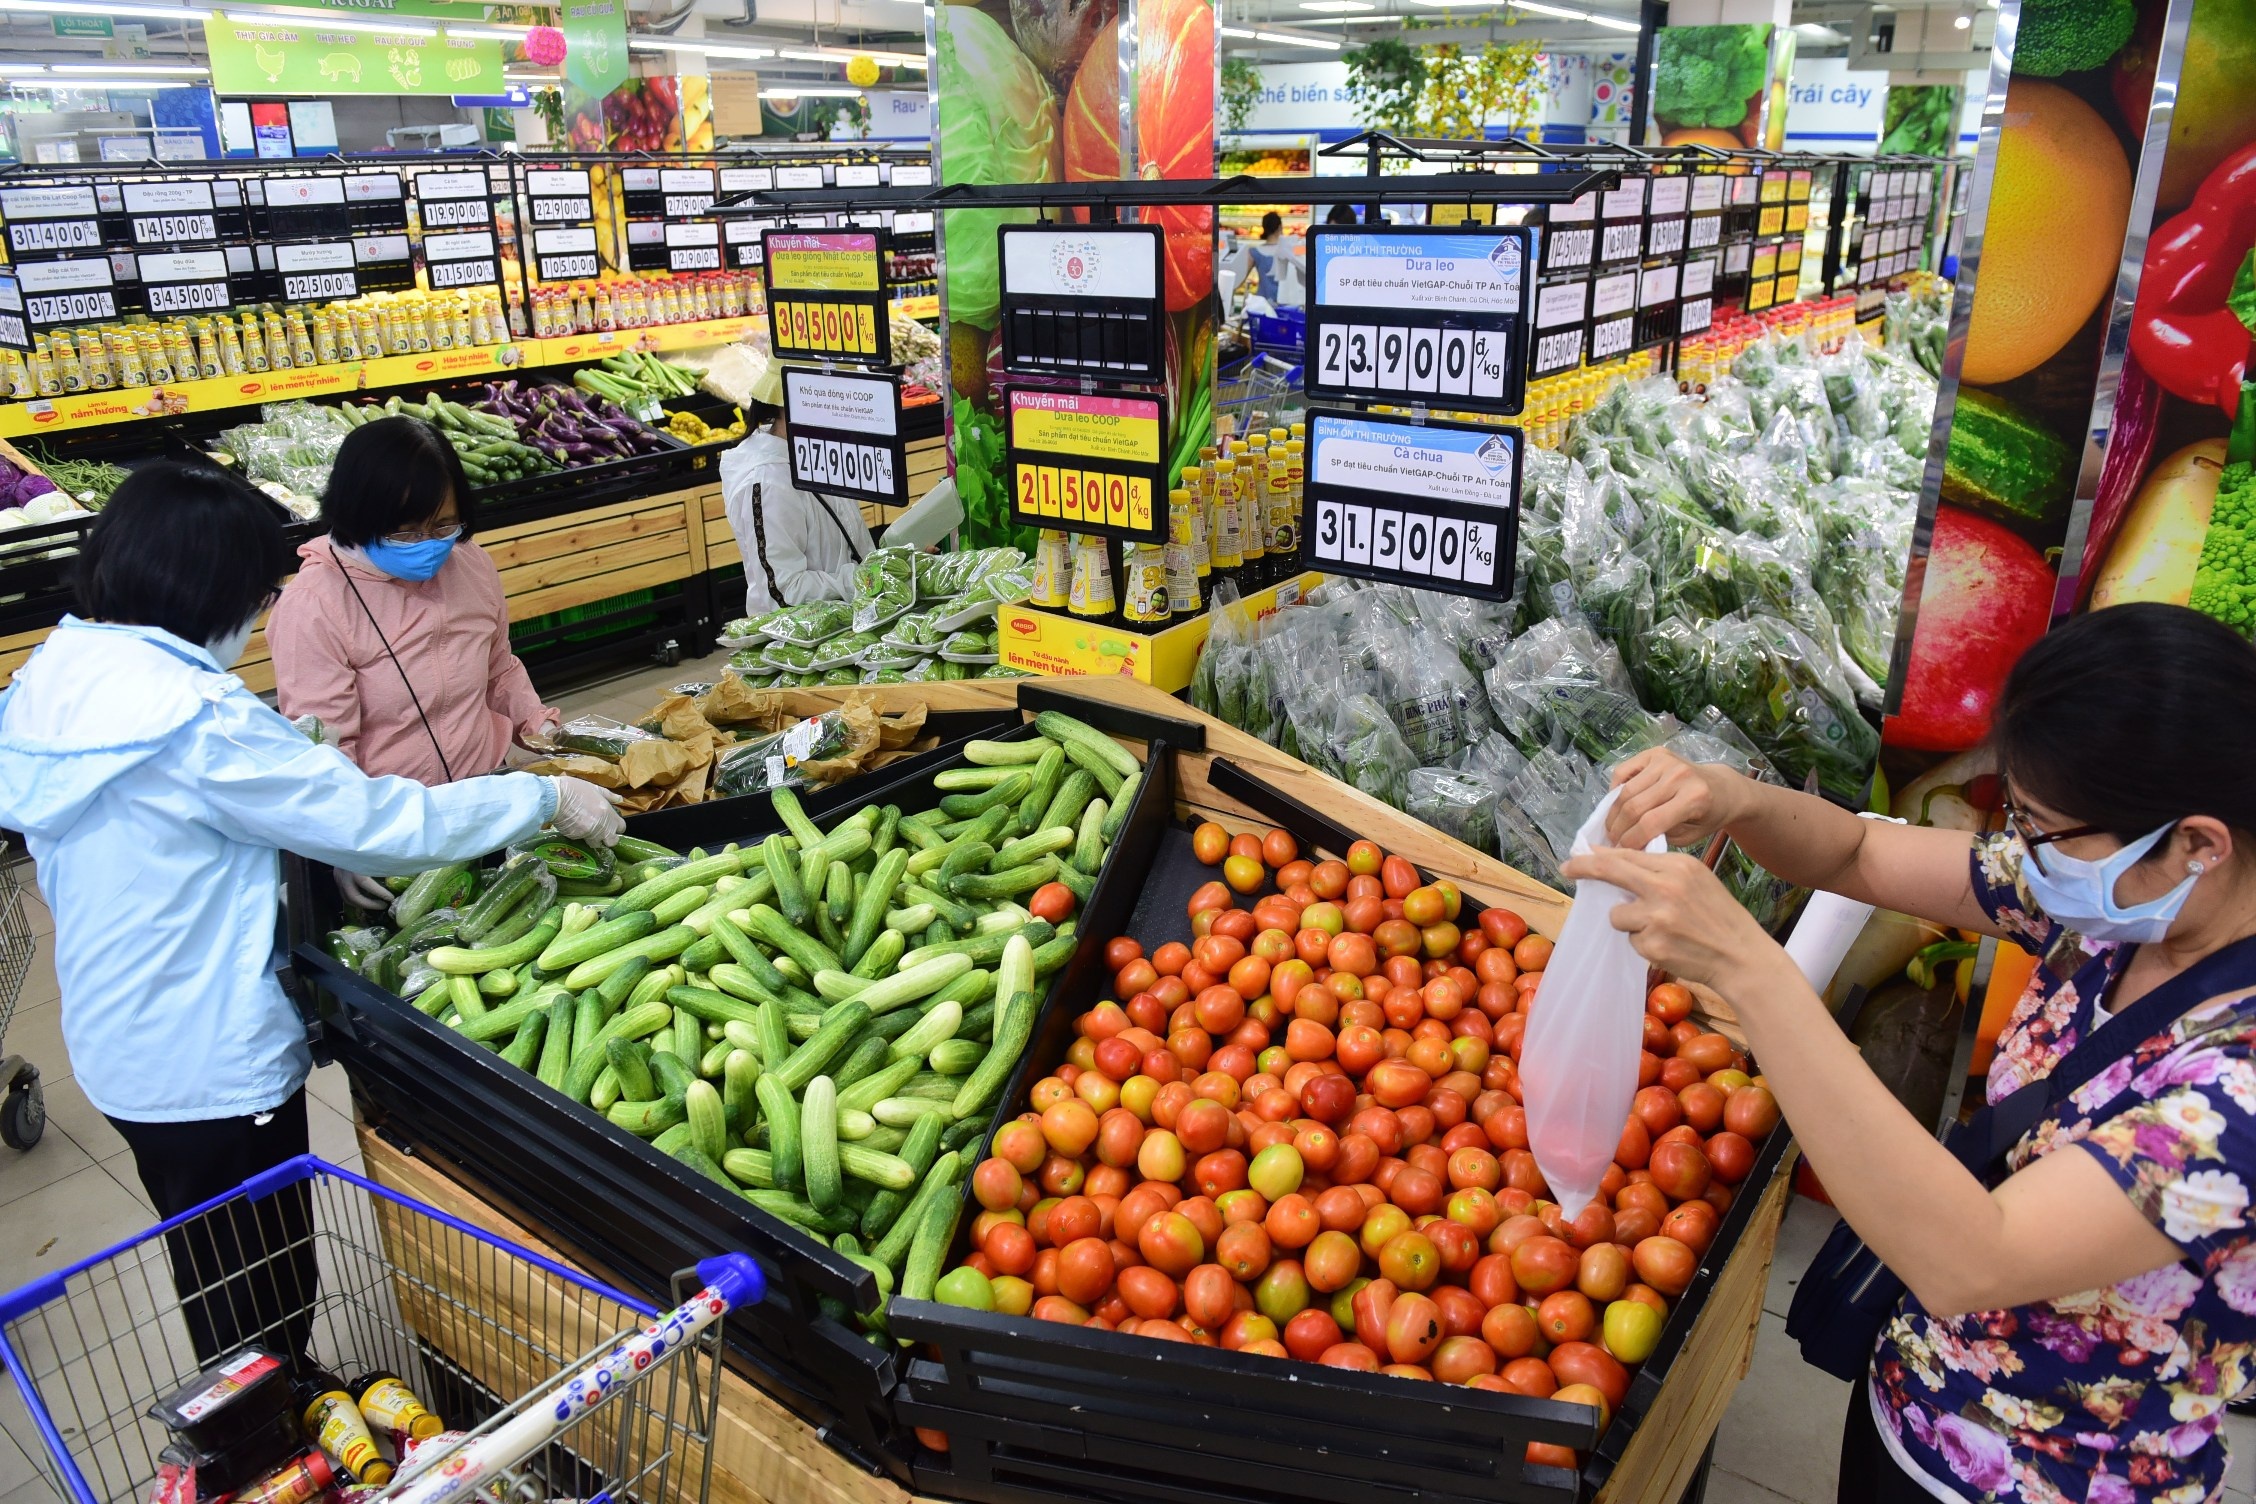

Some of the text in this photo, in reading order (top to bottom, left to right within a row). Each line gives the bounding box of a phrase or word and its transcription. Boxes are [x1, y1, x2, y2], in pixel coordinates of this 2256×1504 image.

[235, 31, 255, 42] THỊT
[258, 31, 275, 41] GIA
[316, 34, 356, 44] THỊT HEO
[375, 37, 392, 45] RAU
[1257, 81, 1328, 104] chế biến
[1831, 84, 1872, 107] cây
[893, 99, 917, 113] Rau
[536, 201, 579, 216] 22.900
[668, 197, 705, 212] 27.900
[428, 205, 476, 221] 19.900
[138, 218, 199, 237] 14.500
[15, 226, 82, 246] 31.400
[769, 236, 820, 251] Khuyến mãi
[1325, 234, 1361, 243] Sản phẩm
[673, 251, 709, 265] 12.900
[823, 251, 839, 263] Nhật
[841, 252, 861, 262] Co.op
[863, 252, 877, 261] Sele
[1325, 244, 1423, 257] BÌNH ỔN THỊ TRƯỜNG
[544, 259, 595, 275] 105.000
[1406, 258, 1455, 271] Dưa leo
[435, 265, 483, 282] 21.500
[288, 277, 343, 294] 22.500
[1339, 278, 1520, 292] SP đạt tiêu chuẩn VietGAP-Chuỗi TP An Toà
[152, 287, 212, 306] 34.500
[31, 297, 97, 317] 37.500
[779, 308, 874, 344] 39.500 đ/kg
[1325, 333, 1500, 380] 23.900 đ/kg
[270, 383, 284, 391] lên
[306, 379, 315, 389] tự
[316, 376, 340, 385] nhiên
[800, 385, 812, 396] Khổ
[814, 389, 826, 399] qua
[828, 388, 844, 401] đóng
[853, 391, 874, 402] COOP
[1012, 393, 1079, 410] Khuyến mãi
[71, 405, 128, 419] nấm hương
[1055, 411, 1120, 426] Dưa leo COOP
[1051, 430, 1068, 441] phẩm
[1069, 433, 1079, 442] đạt
[1080, 434, 1091, 442] tiêu
[1093, 435, 1111, 444] chuẩn
[1113, 438, 1138, 448] VietGAP
[1318, 425, 1412, 445] BÌNH ỔN THỊ TRƯỜNG
[798, 443, 891, 481] 27.900 đ/kg
[1393, 447, 1443, 463] Cà chua
[1331, 458, 1511, 489] SP đạt tiêu chuẩn VietGAP-Chuỗi TP An Toàn
[1022, 472, 1149, 519] 21.500 đ/kg
[1321, 509, 1492, 566] 31.500 đ/kg
[1013, 622, 1034, 630] Maggi
[1008, 652, 1024, 665] lên
[1026, 658, 1050, 672] men
[1032, 650, 1069, 665] Từ đậu nành
